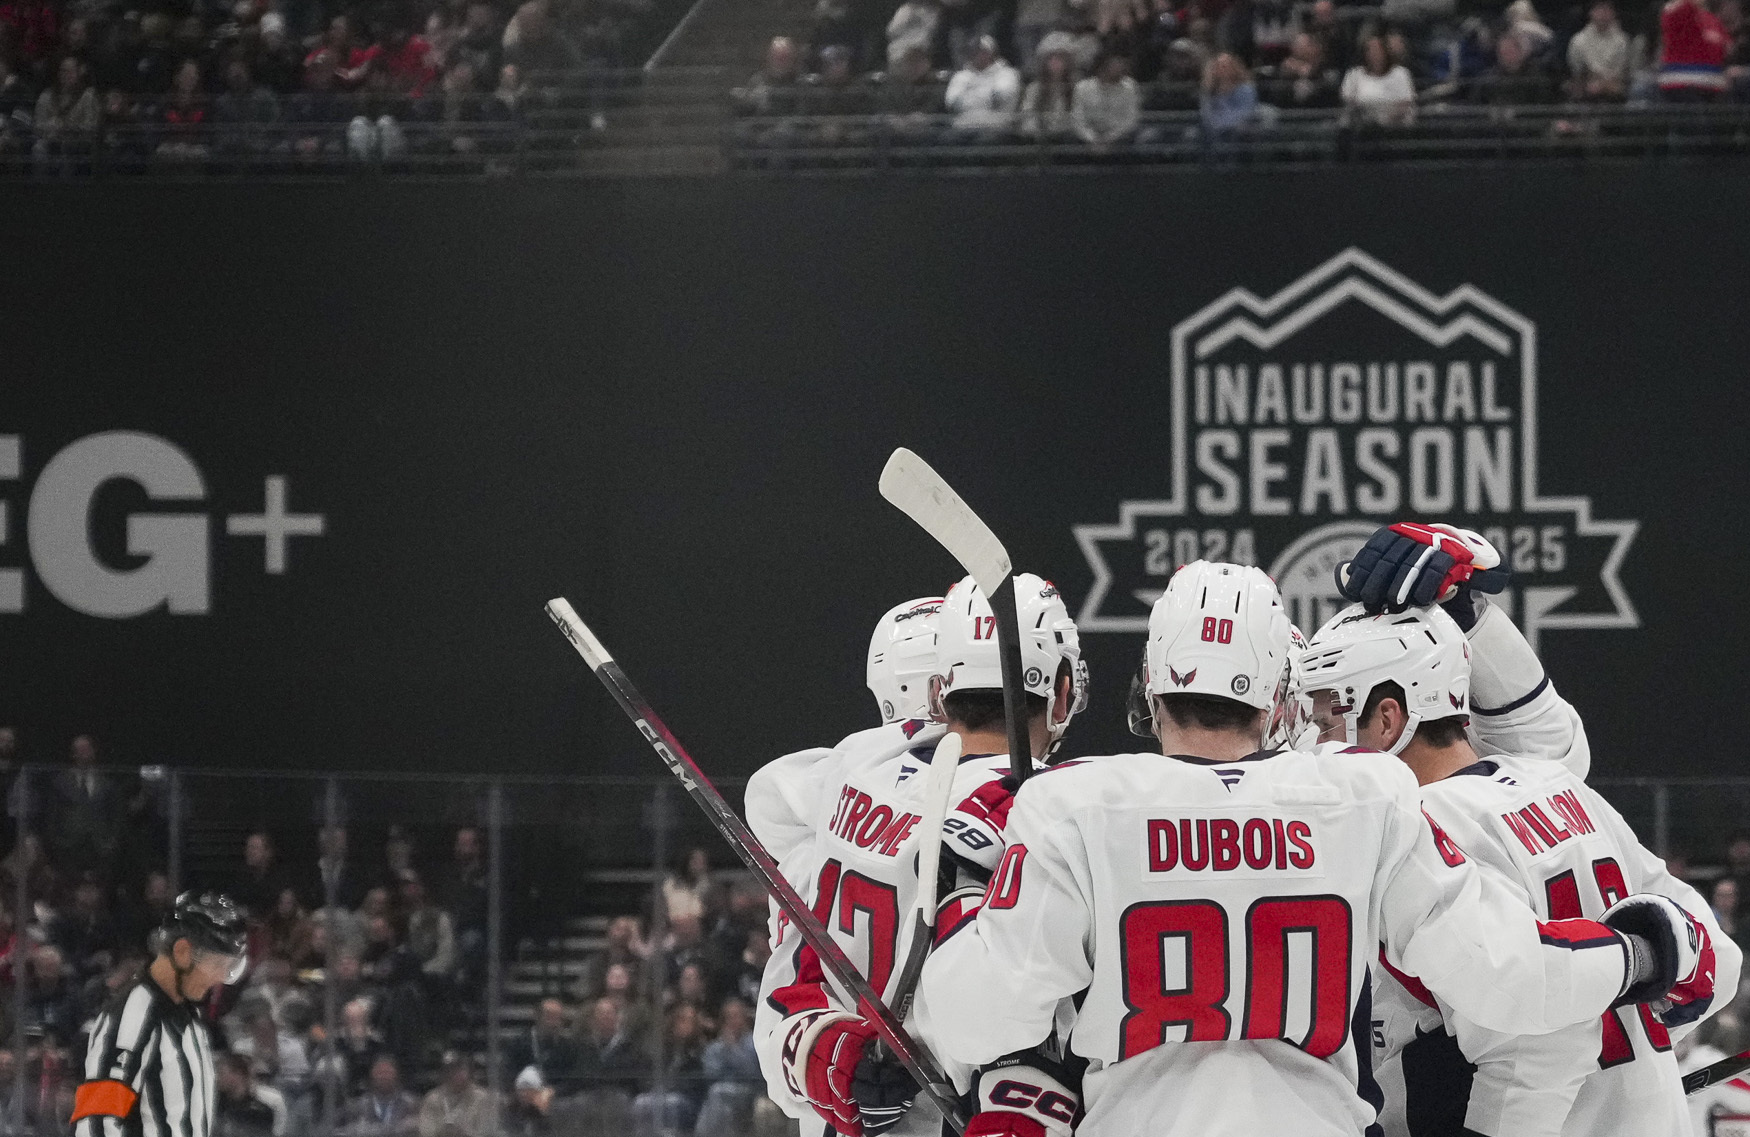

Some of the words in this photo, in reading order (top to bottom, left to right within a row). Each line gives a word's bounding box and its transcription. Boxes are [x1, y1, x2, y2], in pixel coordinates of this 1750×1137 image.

[1195, 359, 1512, 425] INAUGURAL
[1195, 426, 1512, 515] SEASON
[0, 429, 325, 621] G+
[974, 616, 996, 640] 17
[1201, 616, 1233, 644] 80
[635, 718, 698, 792] CCM
[829, 784, 922, 857] STROME
[1147, 817, 1315, 873] DUBOIS
[1501, 788, 1596, 856] WILSON
[1119, 894, 1353, 1063] 80
[988, 1078, 1079, 1125] CC
